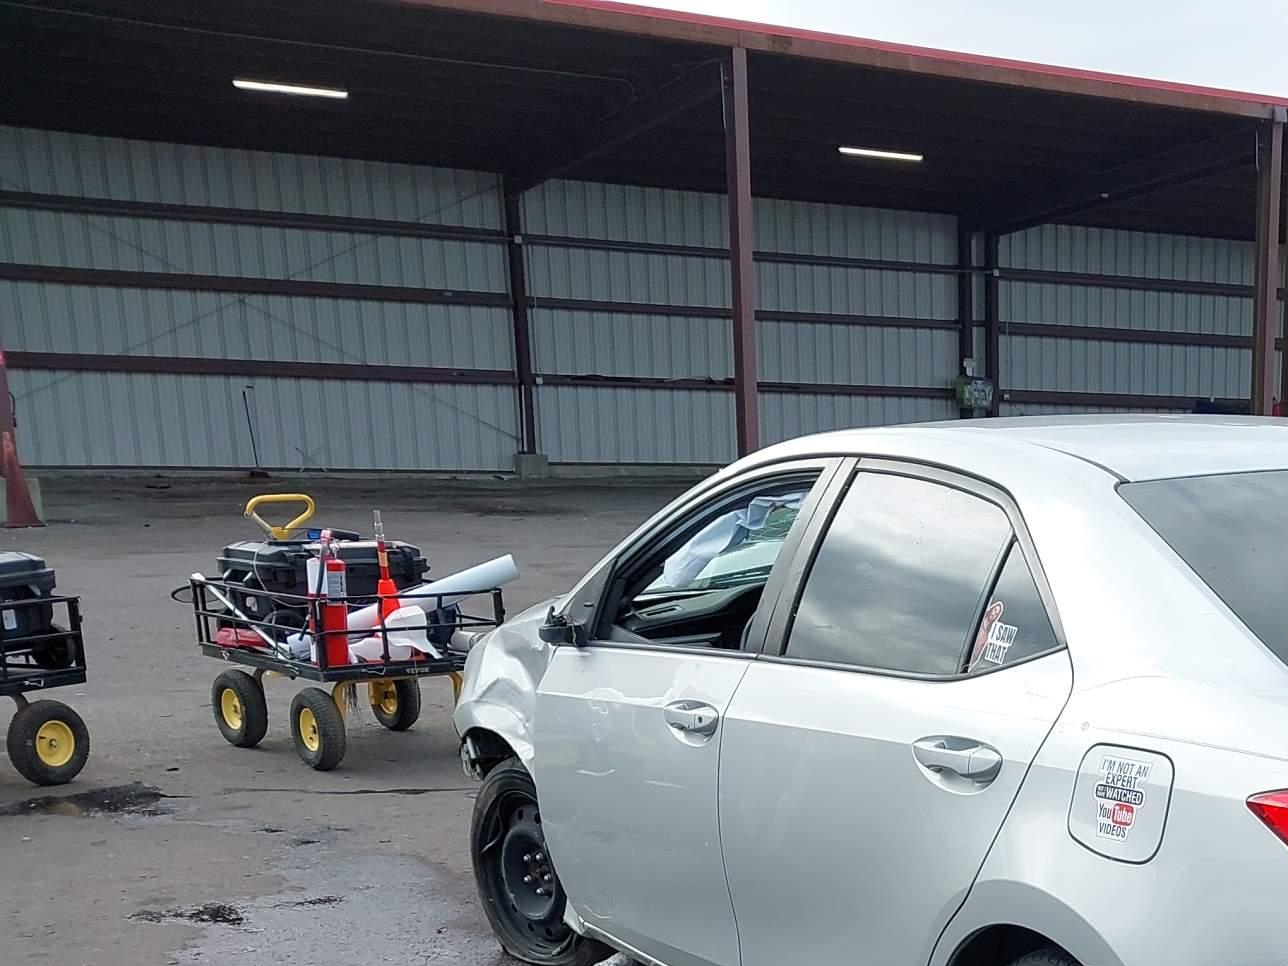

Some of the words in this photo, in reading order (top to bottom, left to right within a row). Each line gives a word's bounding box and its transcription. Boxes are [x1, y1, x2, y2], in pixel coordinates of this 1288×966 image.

[996, 624, 1017, 644] SAW
[986, 643, 1007, 664] THAT
[1102, 758, 1116, 772] I'M
[1117, 761, 1135, 776] NOT
[1136, 764, 1150, 778] AN
[1105, 772, 1138, 789] EXPERT
[1105, 786, 1142, 804] WATCHED
[1099, 822, 1127, 838] VIDEOS
